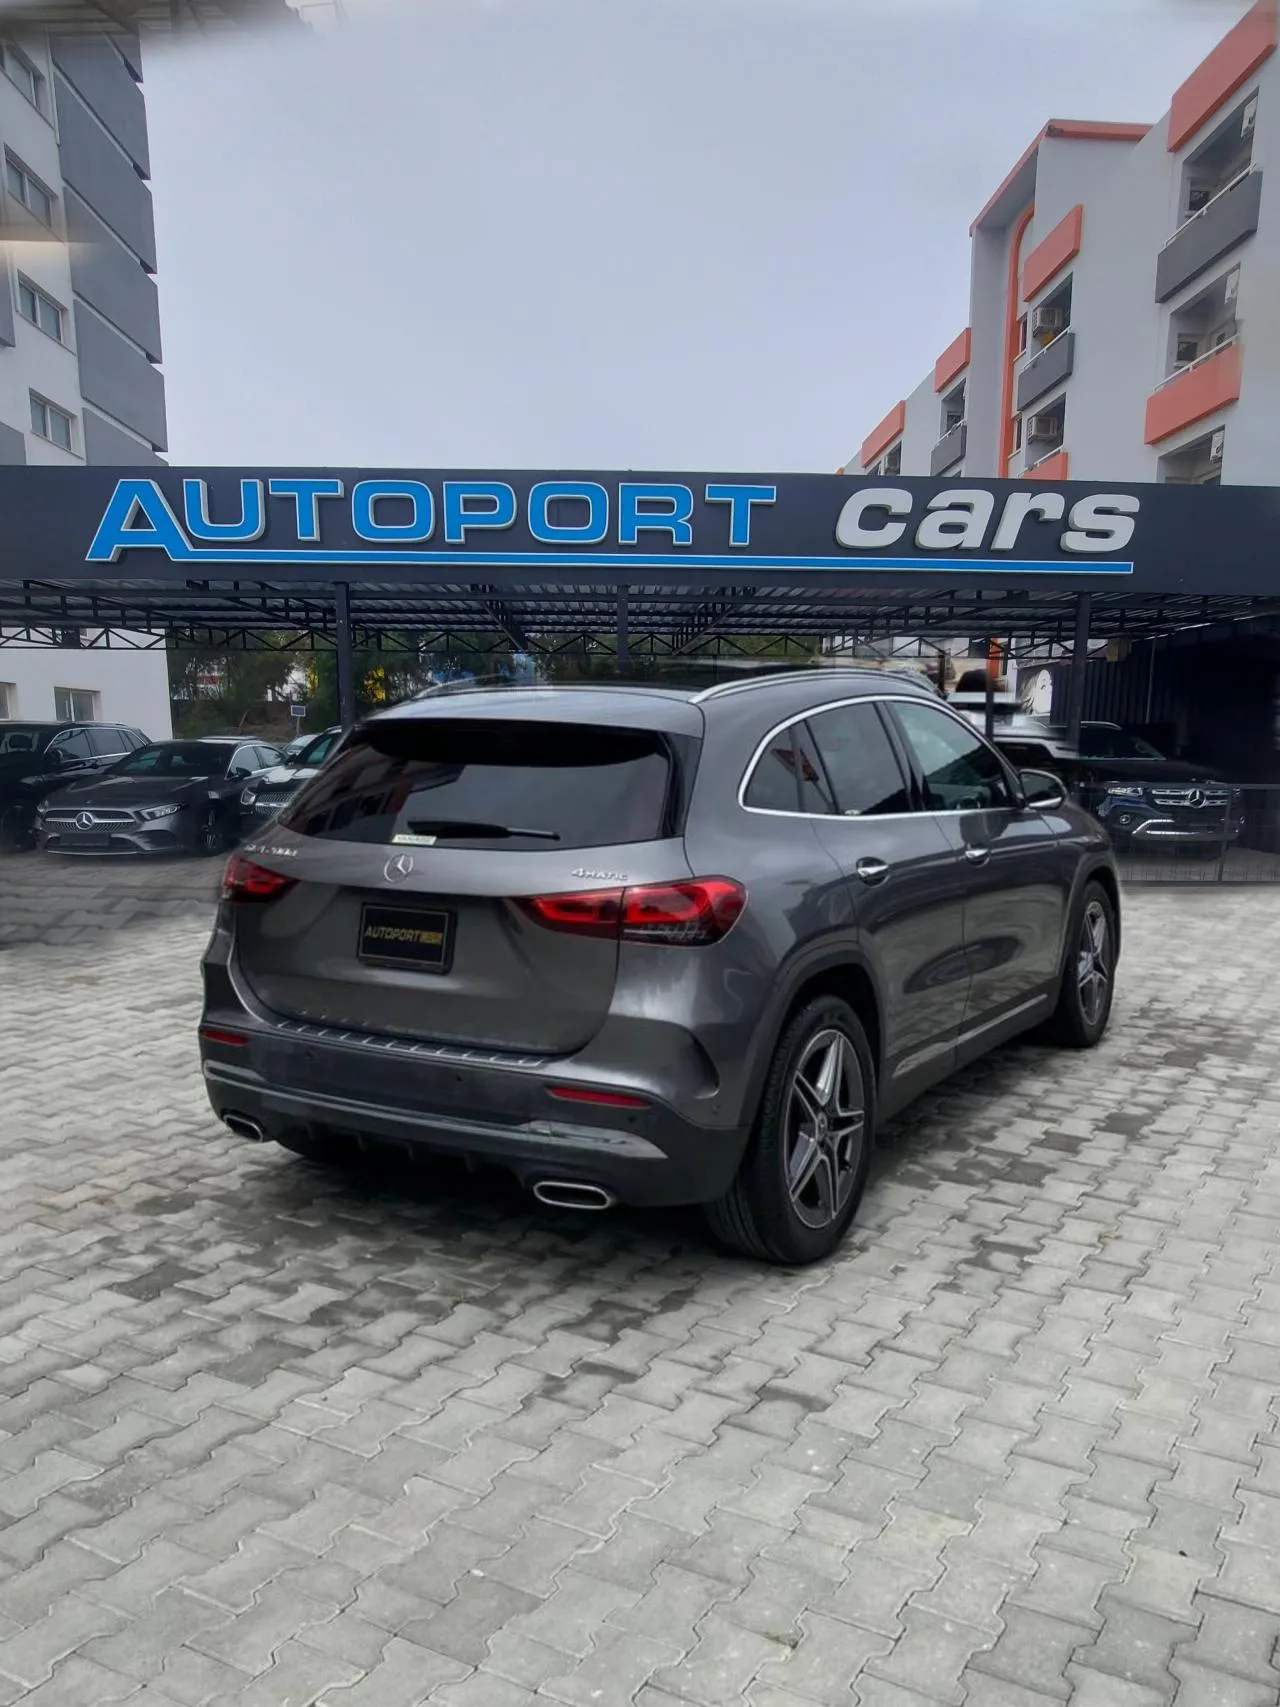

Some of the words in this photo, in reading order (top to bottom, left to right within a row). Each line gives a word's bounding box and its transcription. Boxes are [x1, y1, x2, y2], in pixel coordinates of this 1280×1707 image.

[85, 478, 778, 563] AUTOPORT
[835, 487, 1141, 554] cars
[365, 925, 419, 942] AUTOPORT
